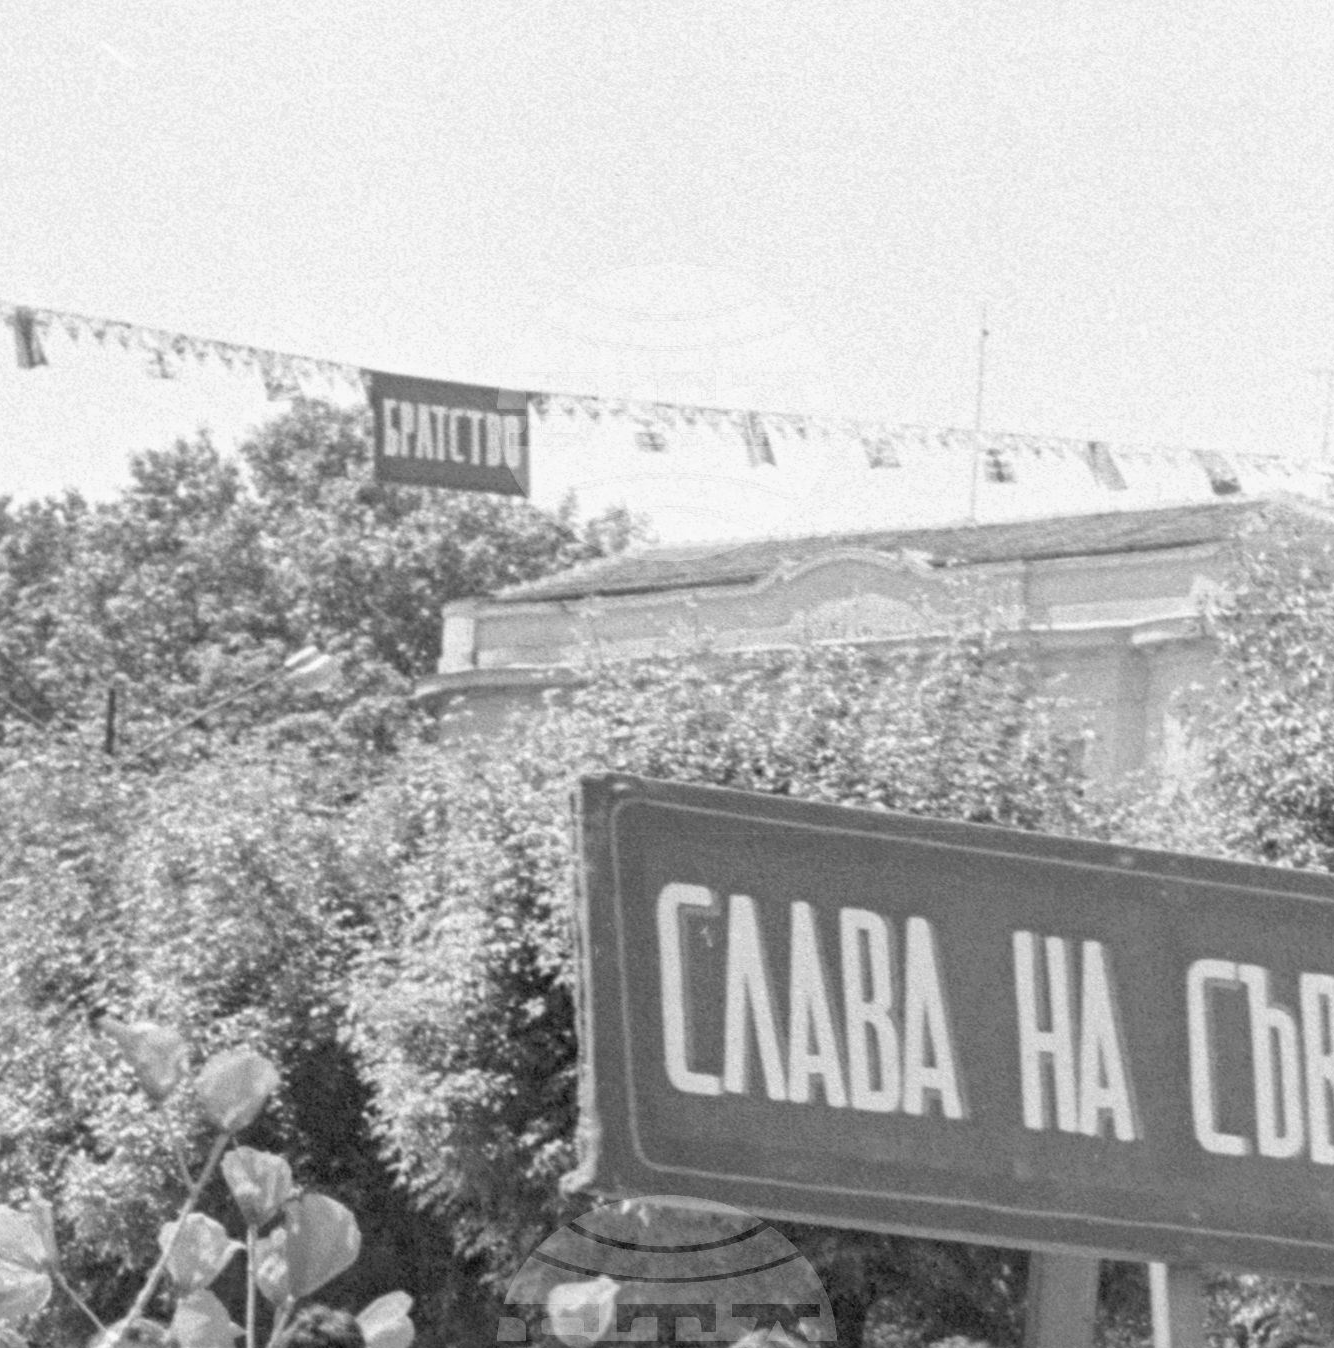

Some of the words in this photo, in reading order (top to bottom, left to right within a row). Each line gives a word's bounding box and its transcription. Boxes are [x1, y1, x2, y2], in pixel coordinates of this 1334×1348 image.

[383, 398, 522, 469] БРАТСТВО
[657, 882, 966, 1121] СЛАВА
[1012, 930, 1139, 1143] НА
